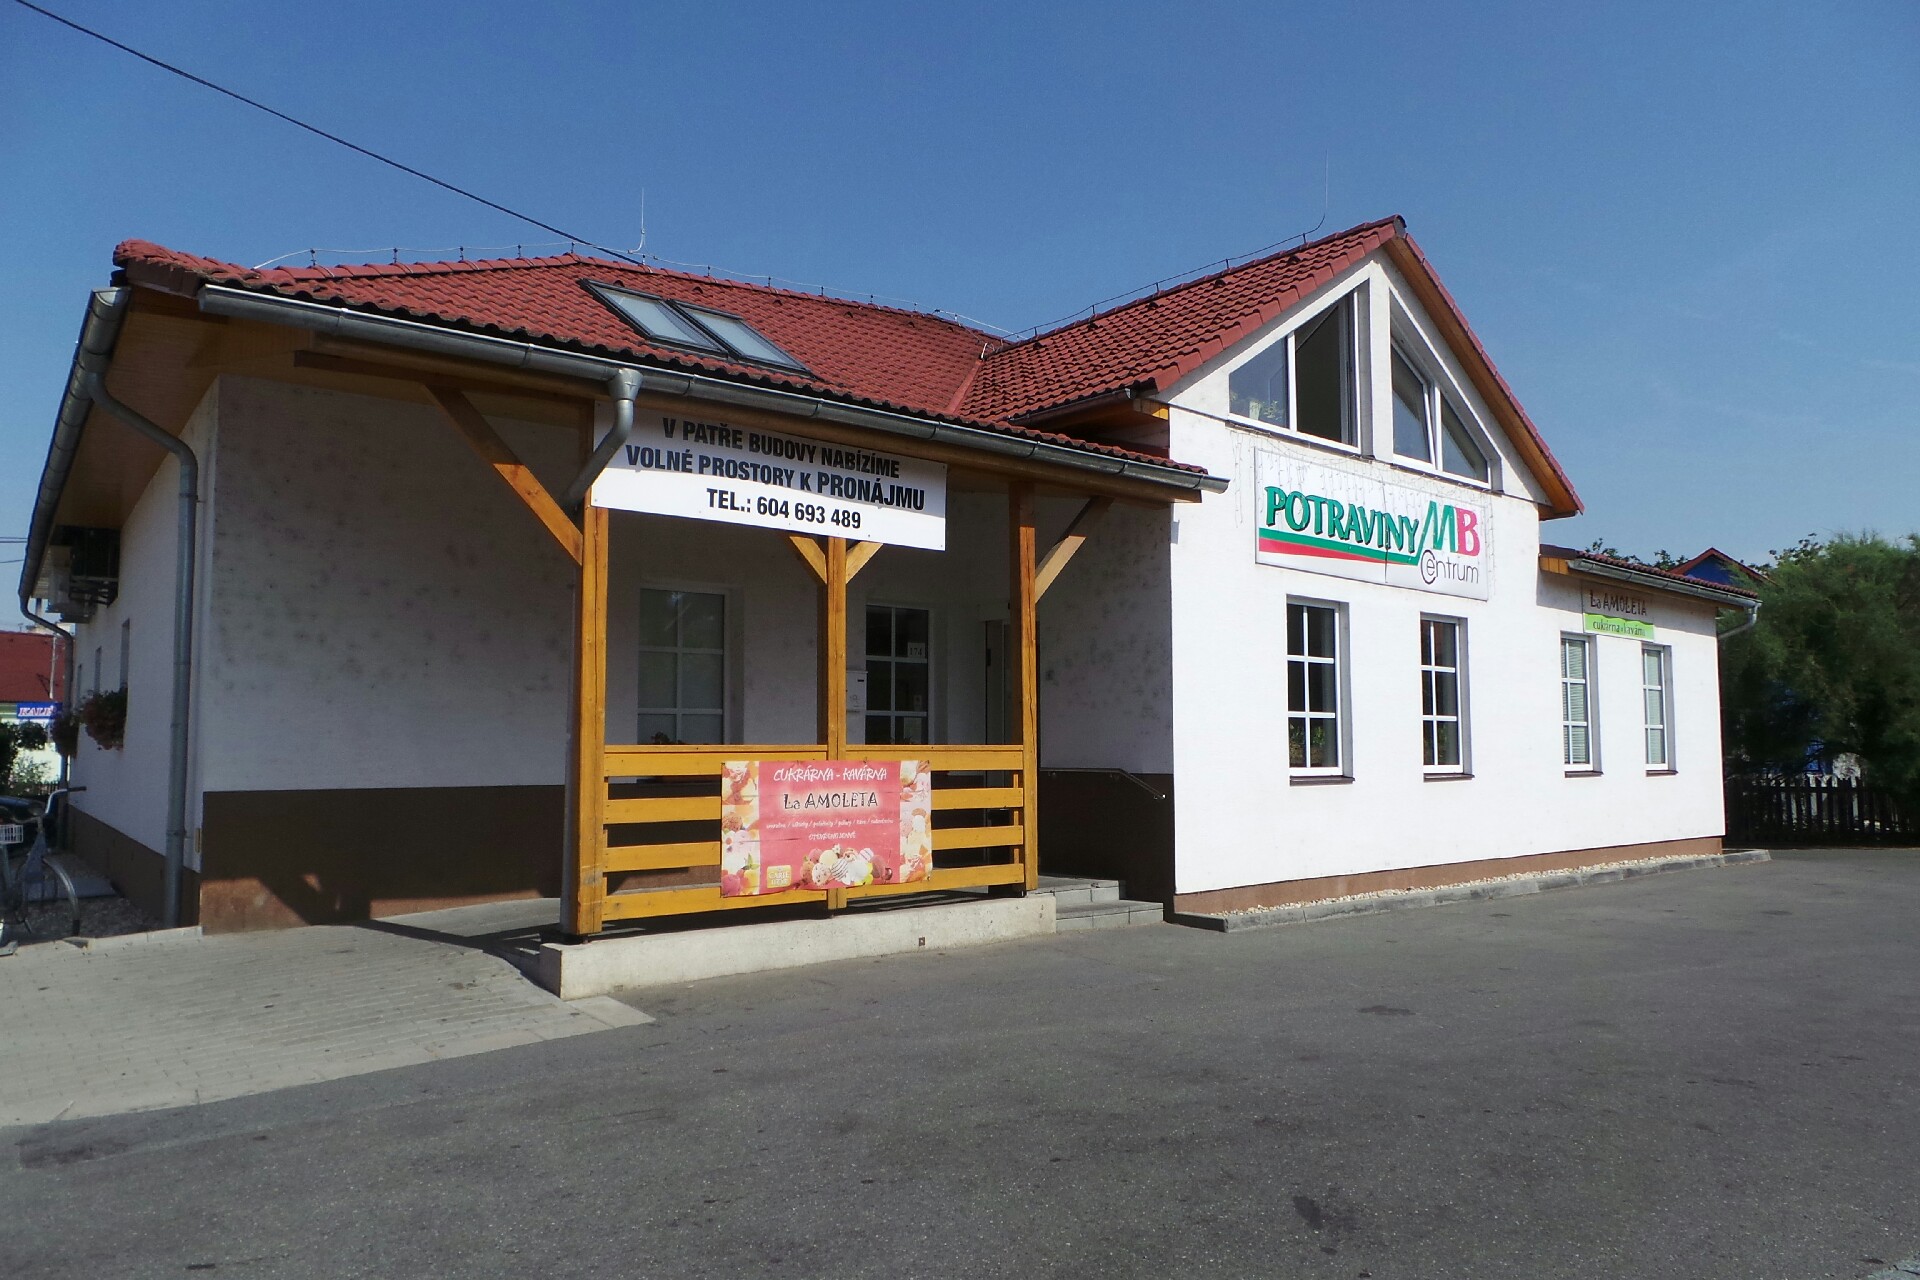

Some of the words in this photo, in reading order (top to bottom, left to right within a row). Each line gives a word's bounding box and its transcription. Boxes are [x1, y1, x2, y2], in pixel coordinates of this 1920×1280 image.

[662, 417, 677, 439] V
[683, 421, 743, 450] PATŘE
[748, 432, 817, 464] BUDOVY
[821, 447, 900, 479] NABÍZÍME
[625, 444, 693, 474] VOLNÉ
[698, 454, 795, 489] PROSTORY
[800, 471, 812, 492] K
[817, 471, 925, 511] PRONÁJMU
[706, 487, 751, 513] TEL.:
[756, 496, 790, 519] 604
[794, 502, 826, 524] 693
[830, 508, 861, 529] 489
[1264, 486, 1420, 554] POTRAVINY
[1420, 549, 1479, 585] Centrum
[1603, 593, 1647, 616] AMOLETA
[773, 765, 834, 782] CUKRÁRNA
[842, 765, 887, 781] KAVÁRNA
[783, 793, 801, 810] La
[804, 791, 879, 810] AMOLETA
